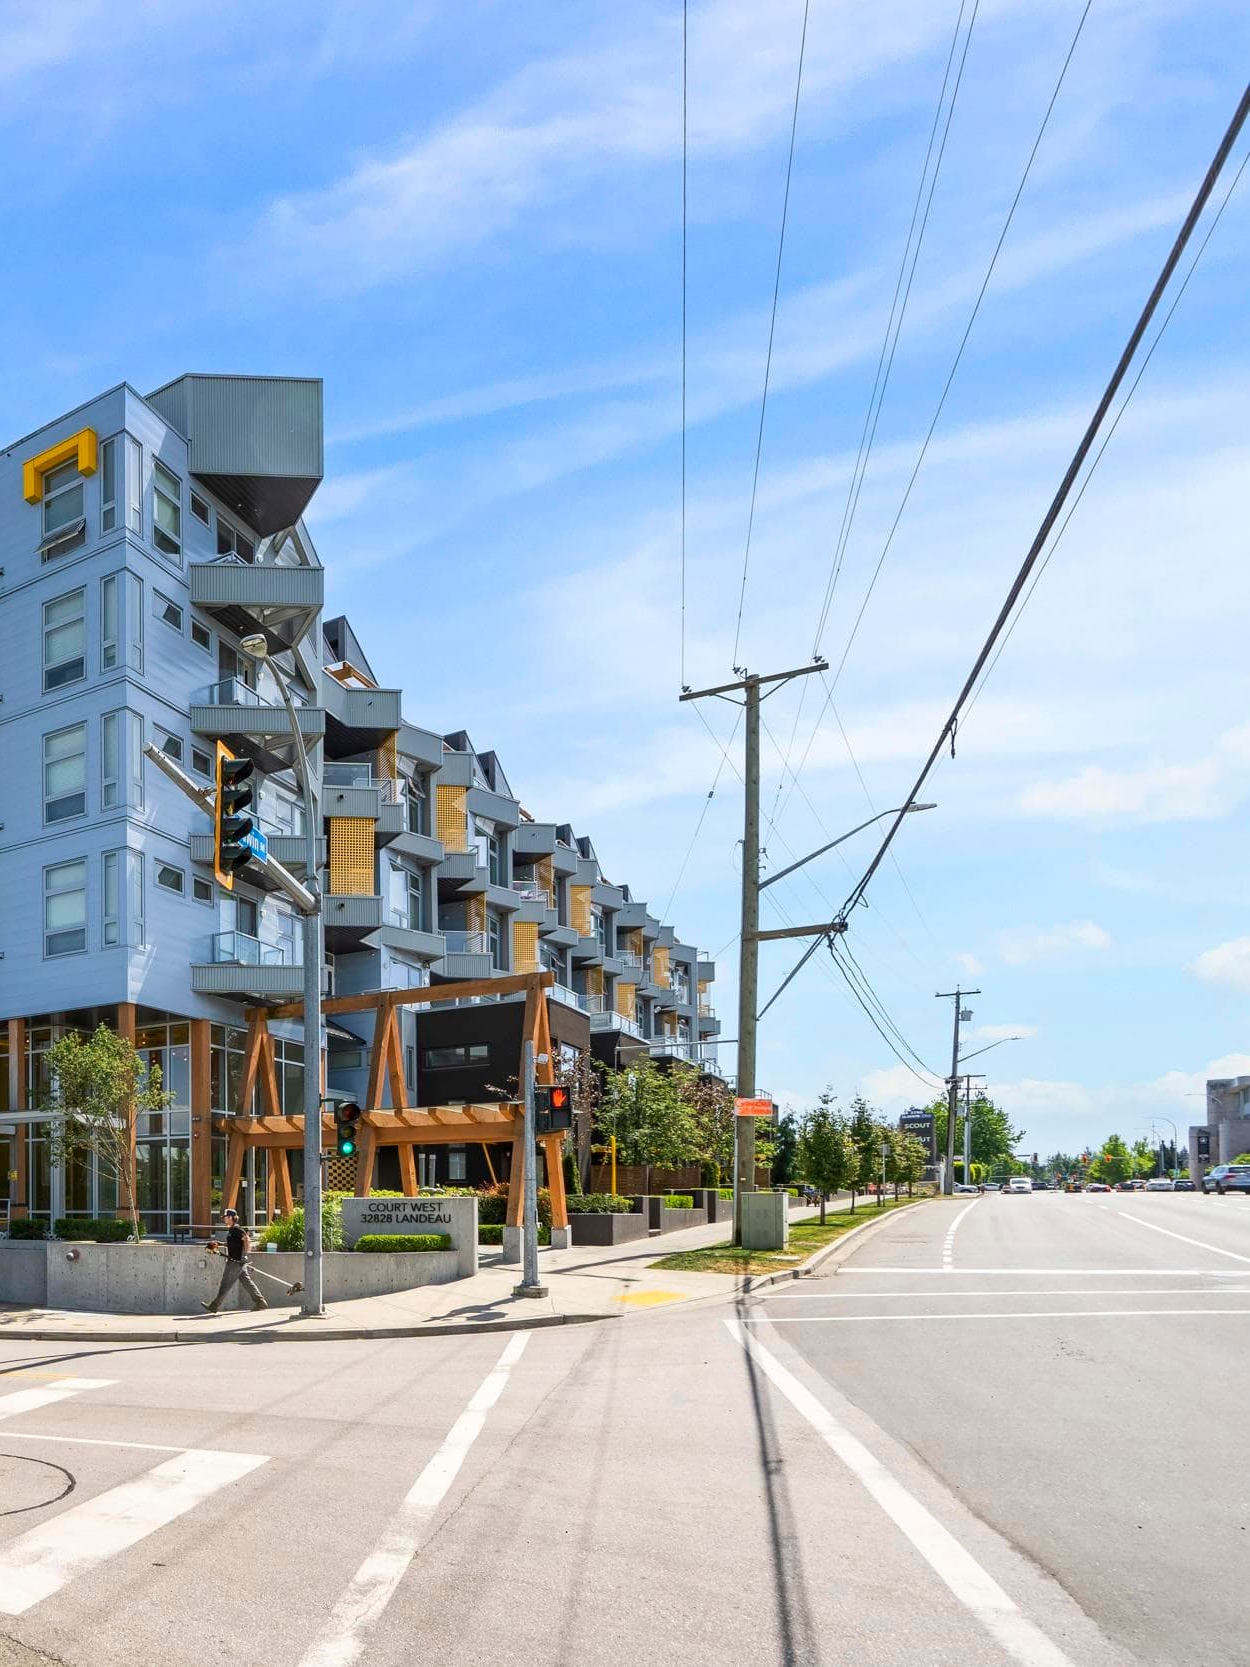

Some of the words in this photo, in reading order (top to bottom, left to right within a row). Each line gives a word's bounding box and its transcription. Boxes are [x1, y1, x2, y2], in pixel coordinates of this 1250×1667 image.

[368, 1202, 408, 1212] COURT
[411, 1202, 444, 1212] WEST
[360, 1213, 393, 1223] 32828
[395, 1213, 452, 1224] LANDEAU
